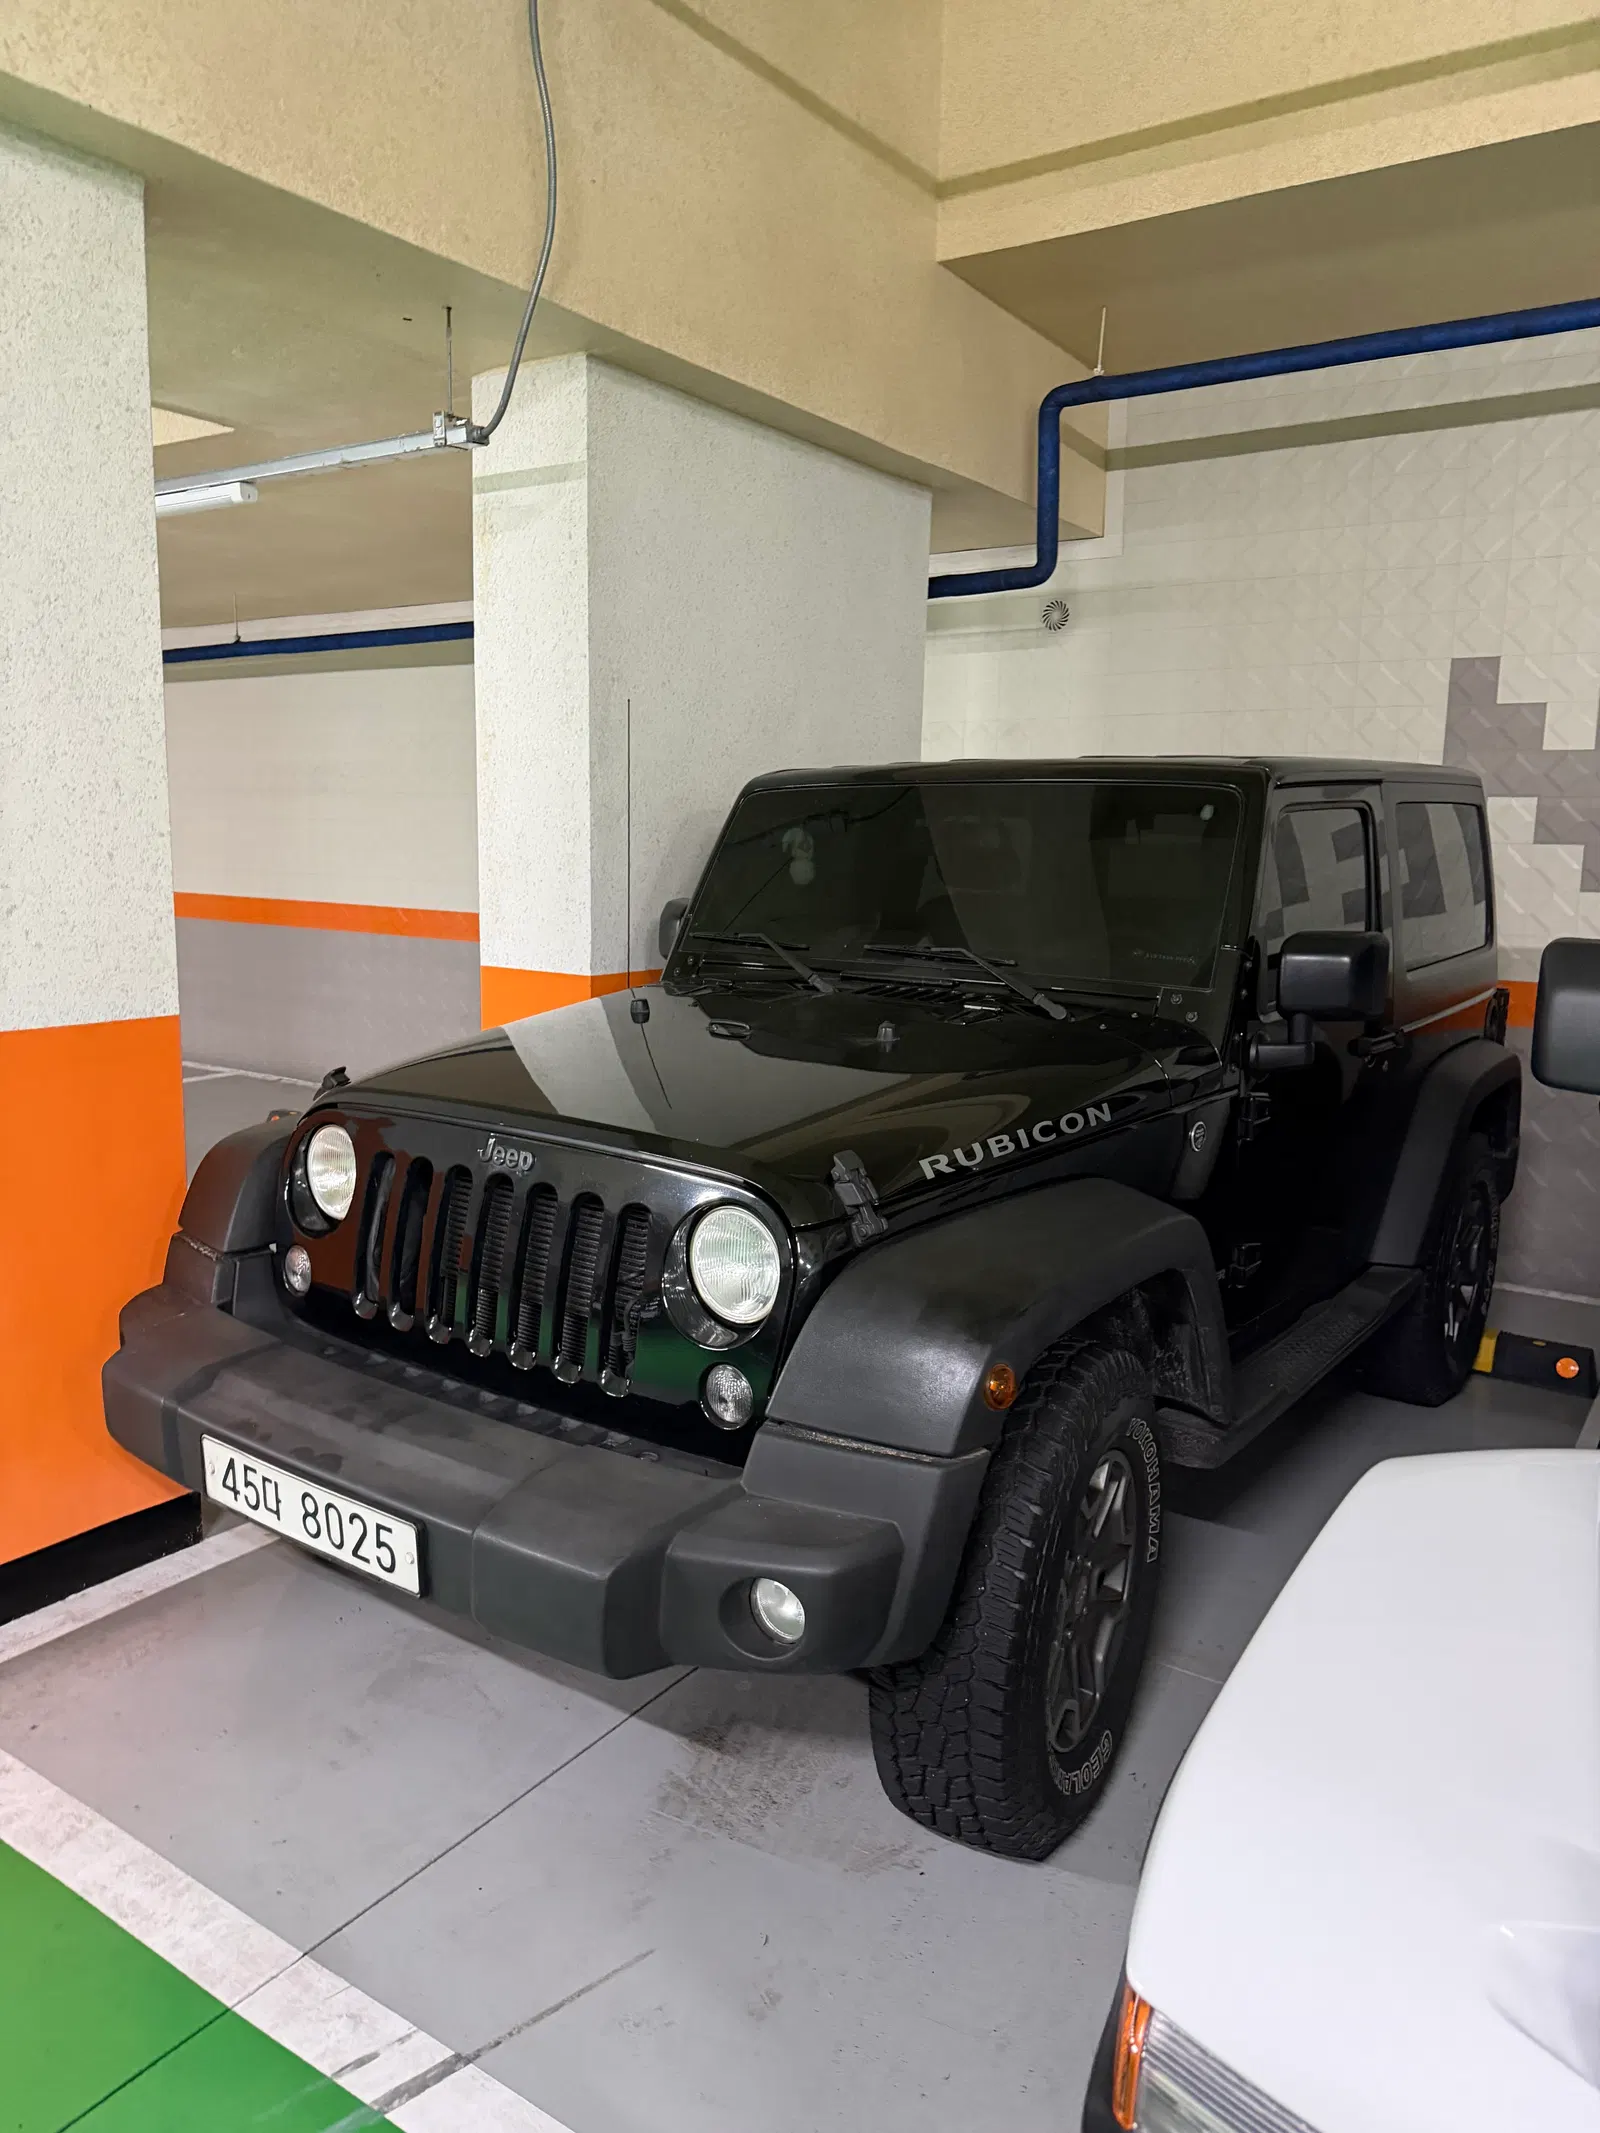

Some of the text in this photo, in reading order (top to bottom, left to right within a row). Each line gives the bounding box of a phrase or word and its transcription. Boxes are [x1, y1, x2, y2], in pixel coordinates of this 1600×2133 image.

[477, 1137, 533, 1177] Jeep
[918, 1102, 1113, 1180] RUBICON
[222, 1457, 396, 1574] 45다 8025
[1125, 1417, 1161, 1563] YOKOHAMA
